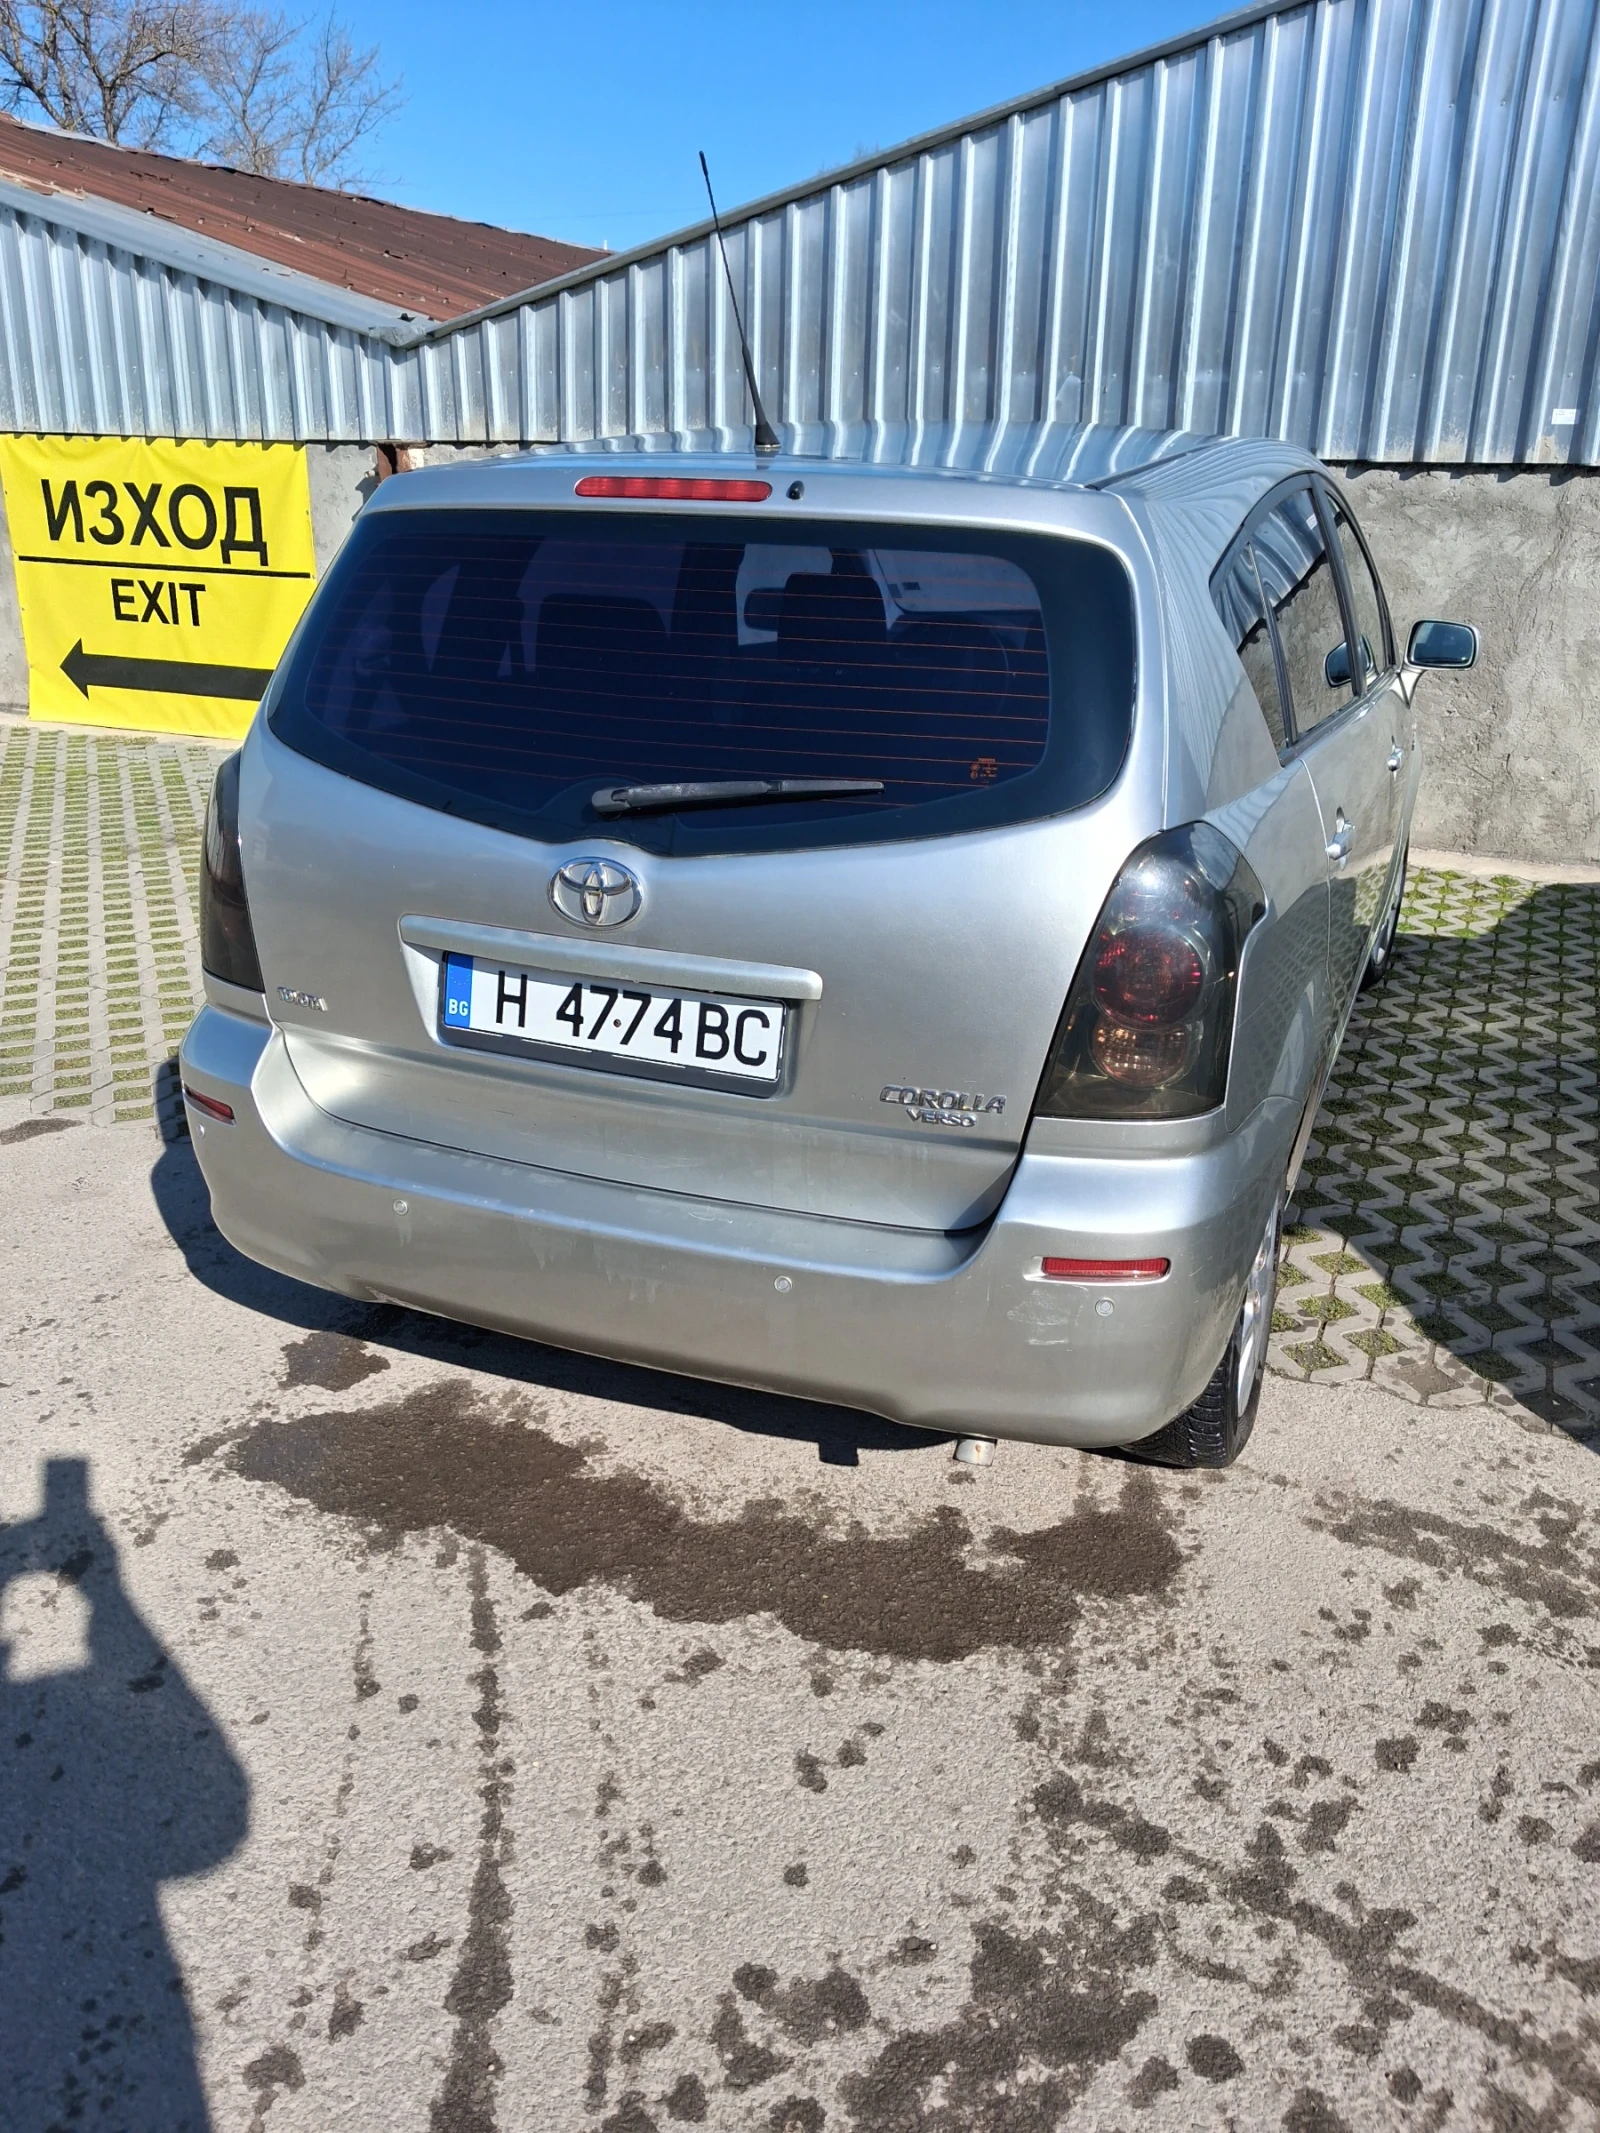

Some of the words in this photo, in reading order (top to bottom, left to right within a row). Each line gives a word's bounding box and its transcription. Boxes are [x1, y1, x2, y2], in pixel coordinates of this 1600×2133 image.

[40, 478, 269, 566] ИЗХОД
[111, 578, 206, 626] EXIT
[448, 998, 469, 1017] BG
[495, 970, 528, 1028] H
[556, 983, 682, 1052] 4774
[695, 1002, 770, 1066] BC
[880, 1084, 1006, 1114] COROLLA
[905, 1107, 978, 1128] VERSO
